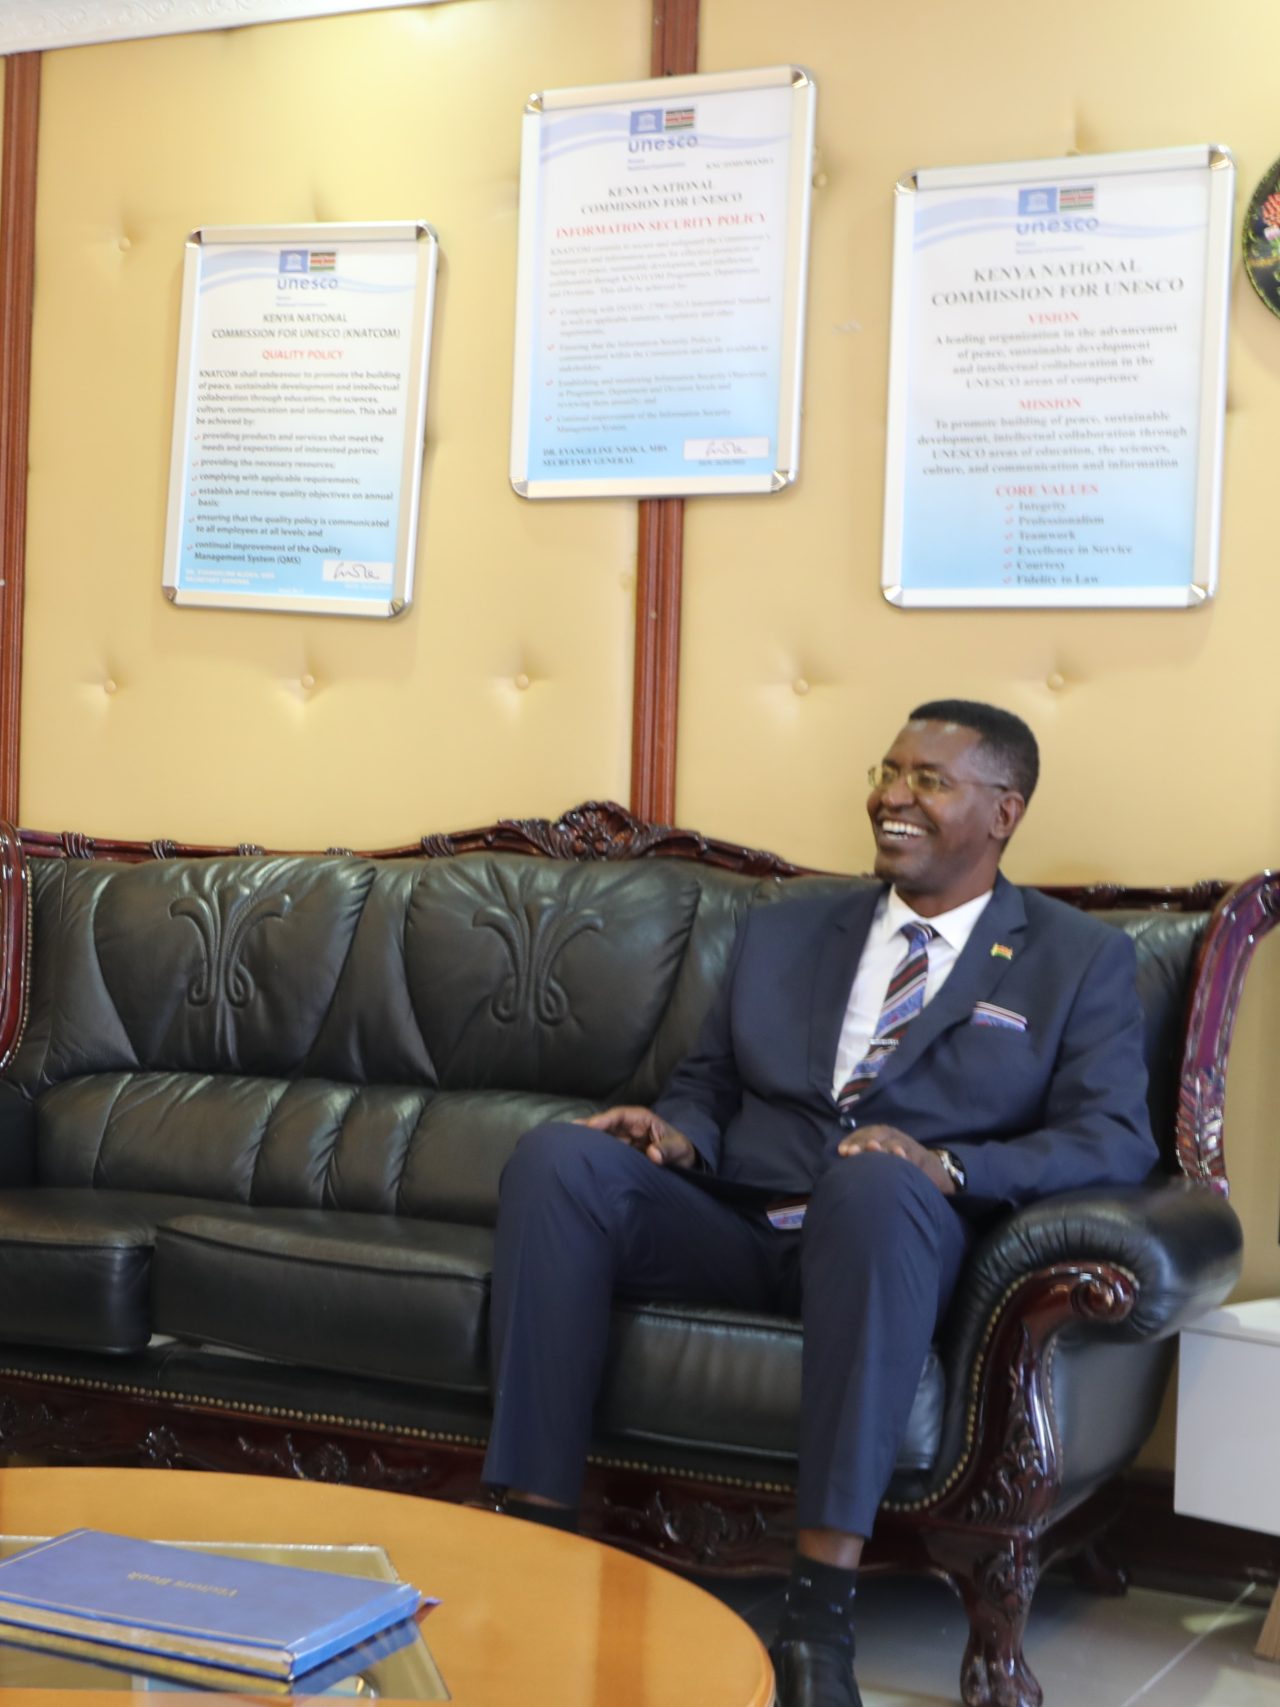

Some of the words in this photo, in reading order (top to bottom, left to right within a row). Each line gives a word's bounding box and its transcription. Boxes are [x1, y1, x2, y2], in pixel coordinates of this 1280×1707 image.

[628, 135, 699, 153] unesco
[607, 184, 649, 198] KENYA
[652, 178, 714, 194] NATIONAL
[579, 197, 661, 216] COMMISSION
[663, 195, 689, 208] FOR
[690, 190, 743, 207] UNESCO
[555, 220, 646, 239] INFORMATION
[648, 215, 713, 231] SECURITY
[717, 210, 767, 226] POLICY
[1017, 217, 1099, 235] unesco
[973, 264, 1036, 283] KENYA
[1042, 257, 1139, 277] NATIONAL
[277, 277, 339, 291] unesco
[931, 285, 1053, 306] COMMISSION
[1060, 281, 1098, 298] FOR
[1104, 276, 1184, 296] UNESCO
[263, 312, 295, 323] KENYA
[297, 312, 348, 323] NATIONAL
[1027, 310, 1080, 325] VISION
[212, 328, 275, 339] COMMISSION
[278, 328, 297, 339] FOR
[300, 328, 341, 339] UNESCO
[343, 328, 401, 340] (KNATCOM)
[945, 333, 986, 346] leading
[1064, 330, 1075, 338] in
[1078, 327, 1095, 338] the
[1100, 323, 1178, 336] advancement
[262, 349, 304, 361] QUALITY
[308, 349, 344, 360] POLICY
[957, 347, 969, 359] of
[1009, 344, 1073, 356] sustainable
[1076, 339, 1150, 355] development
[952, 362, 974, 374] and
[976, 360, 1039, 373] intellectual
[1041, 356, 1118, 371] collaboration
[1121, 357, 1133, 367] in
[1136, 355, 1154, 367] the
[199, 369, 238, 379] KNATCOM
[240, 370, 257, 379] shall
[314, 372, 348, 382] promote
[350, 371, 363, 379] the
[366, 370, 400, 382] building
[965, 377, 1021, 390] UNESCO
[1023, 376, 1054, 387] areas
[1056, 374, 1068, 385] of
[1071, 373, 1140, 387] competence
[198, 381, 207, 391] of
[235, 382, 278, 391] sustainable
[280, 382, 333, 393] development
[336, 383, 351, 392] and
[353, 383, 399, 392] intellectual
[197, 393, 249, 402] collaboration
[250, 393, 282, 404] through
[328, 395, 341, 403] the
[1018, 397, 1082, 410] MISSION
[227, 406, 287, 414] communication
[290, 406, 305, 415] and
[360, 407, 375, 416] This
[377, 407, 398, 417] shall
[196, 416, 206, 425] be
[208, 417, 241, 425] achieved
[935, 417, 949, 431] To
[951, 418, 997, 431] promote
[1000, 415, 1048, 428] building
[1050, 414, 1062, 425] of
[1104, 410, 1171, 423] sustainable
[202, 432, 240, 443] providing
[241, 433, 276, 442] products
[278, 433, 294, 442] and
[295, 434, 327, 442] services
[329, 433, 346, 443] that
[347, 434, 368, 443] meet
[370, 433, 384, 443] the
[993, 429, 1056, 443] intellectual
[1058, 427, 1136, 441] collaboration
[1140, 424, 1188, 439] through
[202, 444, 224, 453] needs
[226, 444, 241, 453] and
[243, 445, 293, 455] expectations
[294, 445, 304, 454] of
[305, 446, 346, 455] interested
[932, 447, 986, 460] UNESCO
[988, 448, 1019, 458] areas
[1021, 445, 1032, 457] of
[1097, 443, 1115, 455] the
[968, 462, 989, 474] and
[992, 460, 1080, 473] communication
[1082, 458, 1104, 471] and
[1107, 457, 1179, 470] information
[199, 472, 240, 484] complying
[241, 473, 259, 482] with
[261, 474, 301, 484] applicable
[198, 486, 233, 496] establish
[235, 488, 250, 497] and
[251, 489, 277, 498] review
[279, 489, 307, 500] quality
[308, 490, 350, 501] objectives
[365, 491, 393, 501] annual
[996, 482, 1036, 498] CORE
[1040, 480, 1099, 497] VALUES
[1019, 499, 1066, 513] Integrity
[196, 514, 231, 524] ensuring
[232, 514, 249, 523] that
[250, 514, 263, 523] the
[264, 516, 294, 526] quality
[294, 516, 319, 526] policy
[328, 518, 390, 529] communicated
[1019, 514, 1104, 527] Professionalism
[196, 525, 205, 533] to
[206, 525, 216, 533] all
[217, 526, 259, 536] employees
[260, 528, 269, 536] at
[270, 527, 280, 536] all
[308, 529, 323, 538] and
[1019, 529, 1076, 541] Teamwork
[195, 541, 232, 551] continual
[233, 542, 286, 553] improvement
[287, 544, 296, 553] of
[297, 544, 311, 553] the
[312, 545, 342, 556] Quality
[1018, 544, 1075, 557] Excellence
[1078, 544, 1089, 554] in
[1092, 543, 1132, 555] Service
[194, 552, 246, 563] Management
[247, 554, 276, 565] System
[277, 555, 302, 567] (QMS)
[1016, 559, 1065, 572] Courtesy
[1016, 574, 1058, 586] Fidelity
[1061, 574, 1072, 584] to
[1075, 573, 1098, 585] Law
